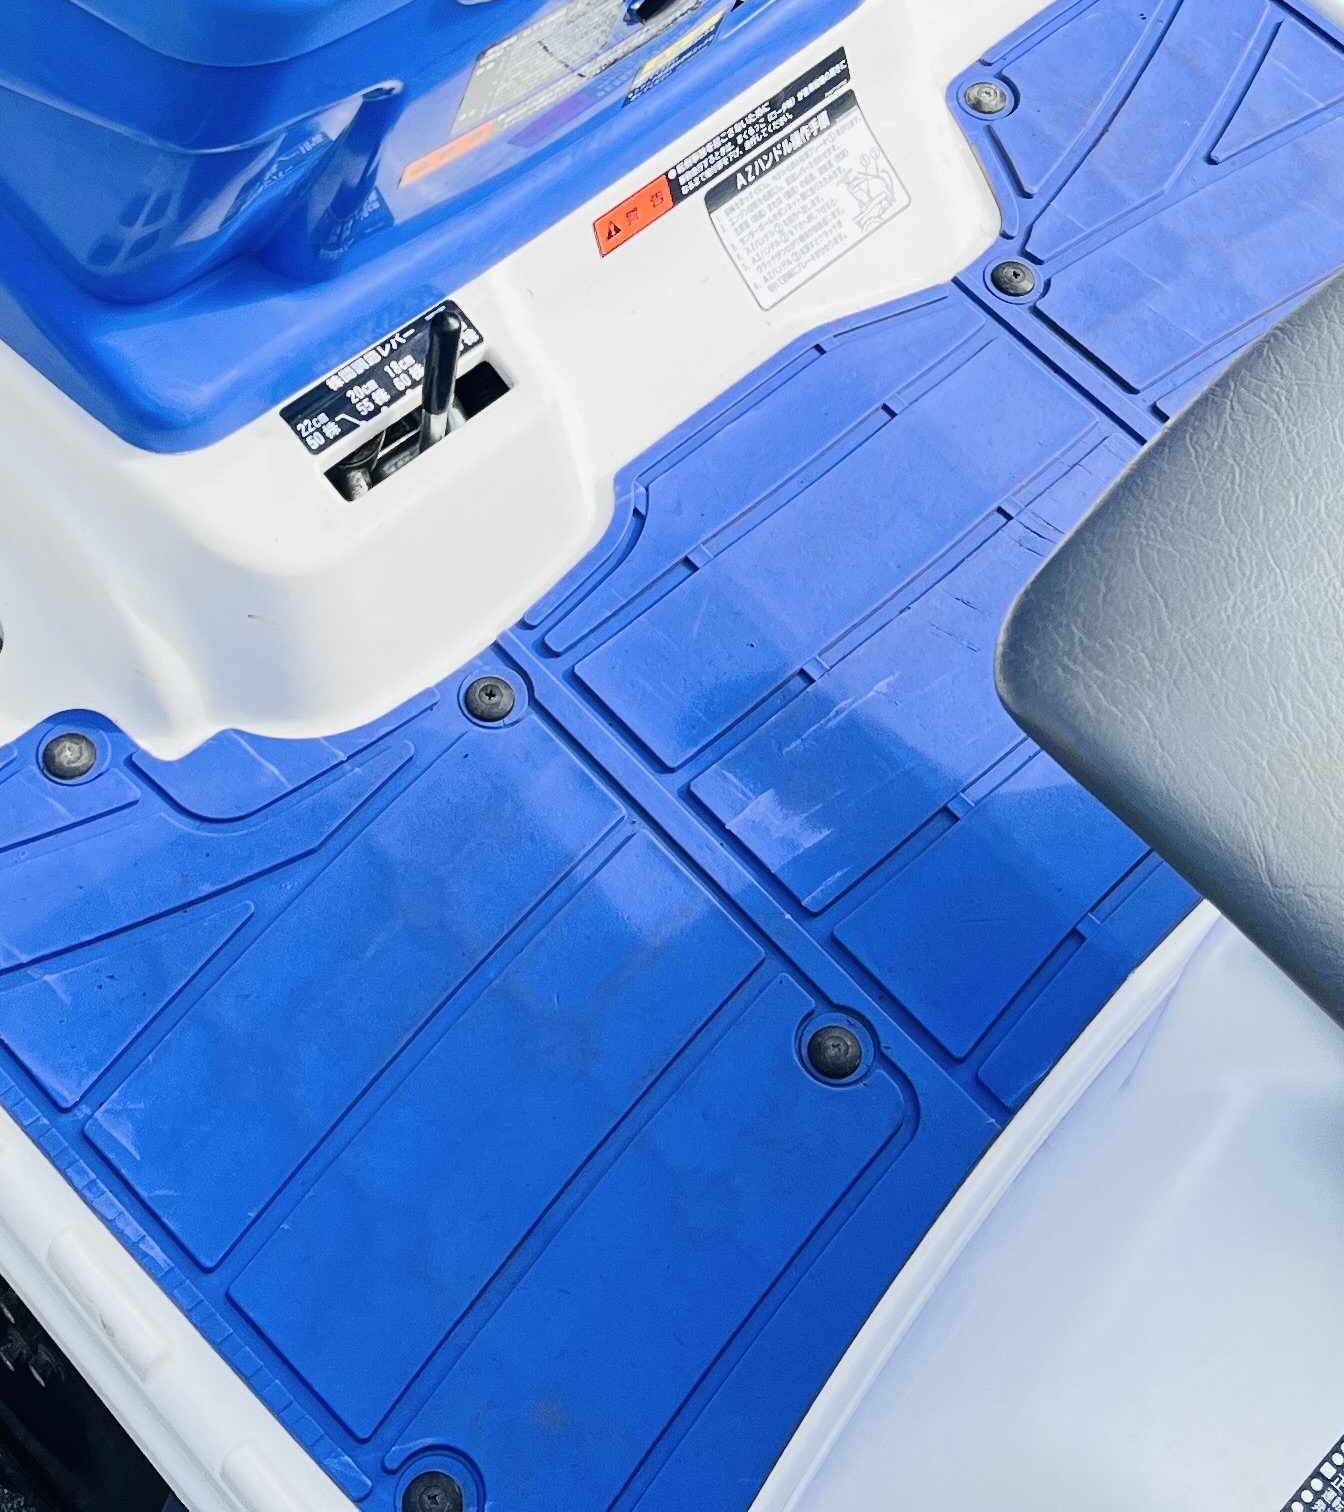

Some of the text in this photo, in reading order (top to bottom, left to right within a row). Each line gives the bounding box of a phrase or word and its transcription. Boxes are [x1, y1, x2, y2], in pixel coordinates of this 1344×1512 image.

[384, 354, 416, 379] 18cm
[346, 379, 379, 404] 20cm
[296, 412, 330, 438] 22cm
